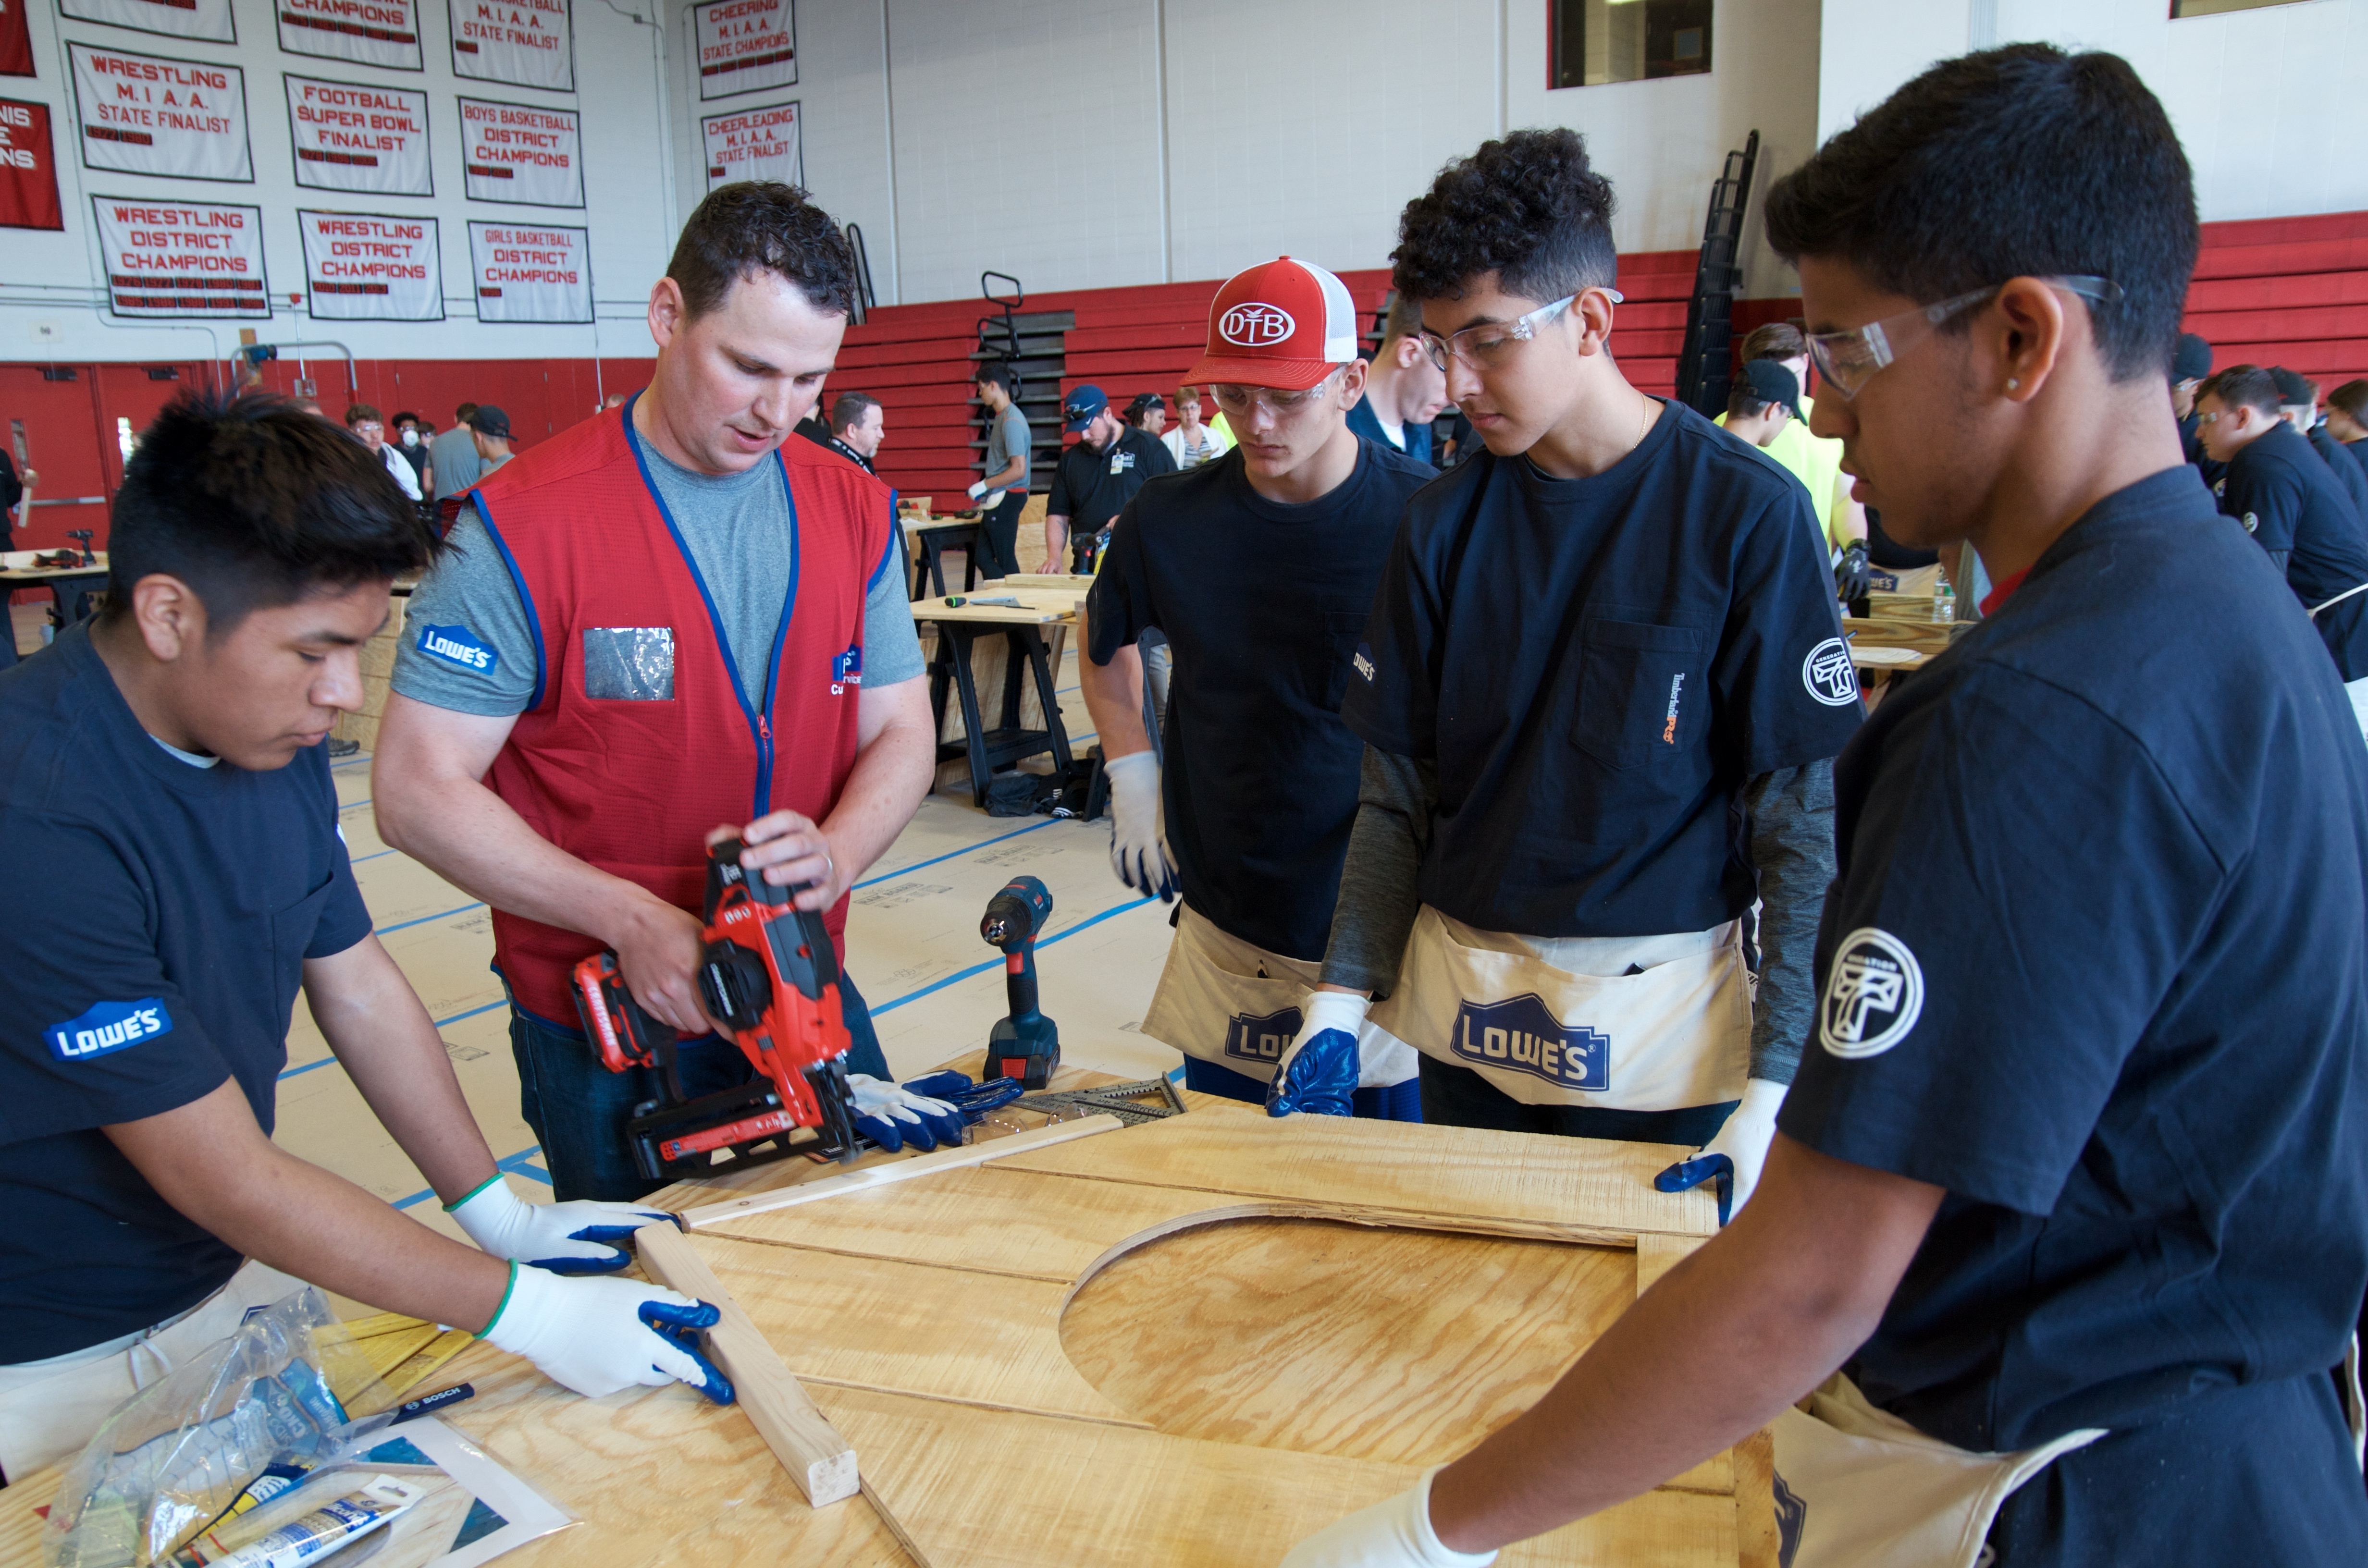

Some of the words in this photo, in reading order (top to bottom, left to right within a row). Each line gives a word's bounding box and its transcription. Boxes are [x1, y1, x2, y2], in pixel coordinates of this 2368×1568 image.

[291, 0, 404, 25] CHAMPIONS
[710, 0, 778, 23] CHEERING
[464, 21, 503, 41] STATE
[506, 28, 558, 50] FINALIST
[703, 43, 732, 61] STATE
[735, 31, 789, 54] CHAMPIONS
[90, 54, 226, 89] WRESTLING
[304, 86, 410, 111] FOOTBALL
[98, 103, 152, 127] STATE
[158, 111, 230, 134] FINALIST
[297, 106, 365, 127] SUPER
[370, 115, 421, 133] BOWL
[464, 105, 497, 123] BOYS
[501, 110, 574, 131] BASKETBALL
[709, 109, 793, 135] CHEERLEADING
[319, 130, 405, 152] FINALIST
[484, 128, 558, 148] DISTRICT
[476, 147, 568, 168] CHAMPIONS
[716, 147, 745, 164] STATE
[747, 141, 789, 159] FINALIST
[113, 206, 243, 228] WRESTLING
[131, 231, 232, 249] DISTRICT
[318, 220, 422, 239] WRESTLING
[485, 229, 512, 244] GIRLS
[516, 231, 572, 247] BASKETBALL
[332, 242, 412, 258] DISTRICT
[494, 249, 567, 265] DISTRICT
[121, 252, 247, 272] CHAMPIONS
[321, 262, 425, 279] CHAMPIONS
[486, 269, 577, 283] CHAMPIONS
[424, 630, 492, 669] LOWE'S
[1353, 652, 1375, 682] OWE'S
[57, 1008, 160, 1056] LOWE'S
[1462, 1014, 1588, 1080] LOWE'S
[422, 1387, 461, 1404] BOSCH
